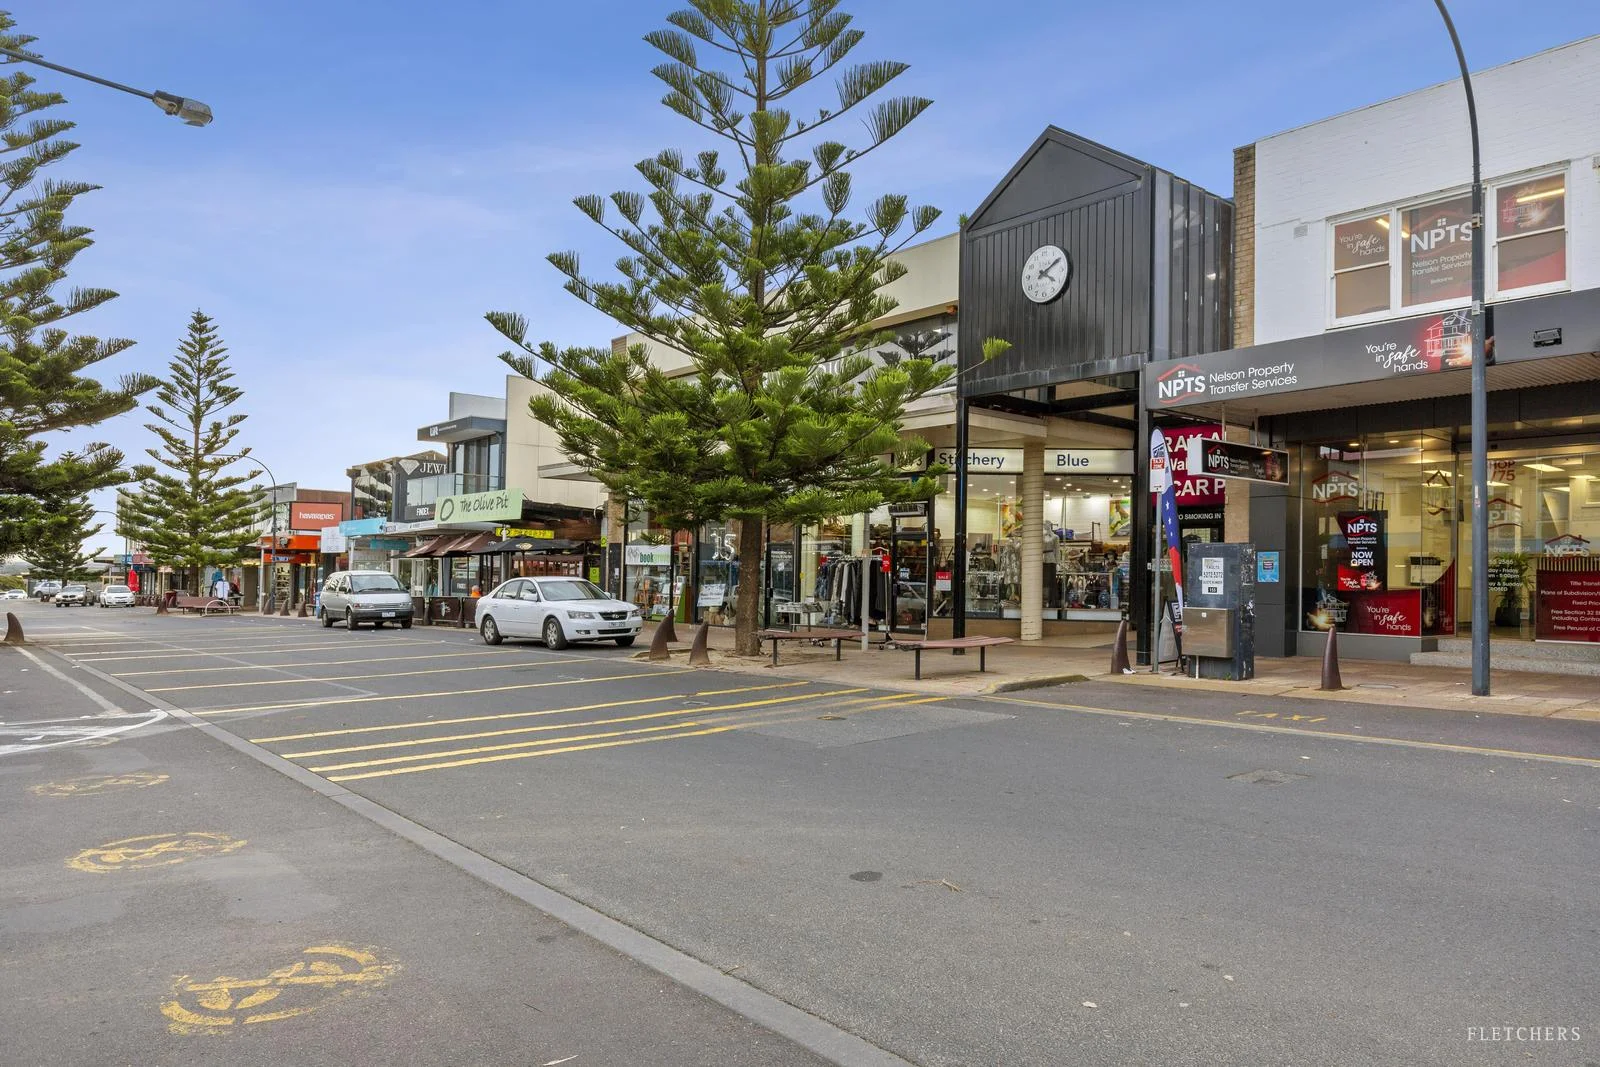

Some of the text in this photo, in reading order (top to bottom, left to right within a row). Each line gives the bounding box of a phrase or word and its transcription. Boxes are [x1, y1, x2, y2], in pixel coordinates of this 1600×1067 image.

[1340, 233, 1362, 244] You're
[1411, 221, 1472, 253] NPTS
[1360, 245, 1385, 256] hands
[1366, 342, 1397, 354] You're
[1376, 344, 1421, 369] in safe
[1209, 362, 1295, 384] Nelson Property
[1394, 360, 1429, 373] hands
[1158, 375, 1206, 399] NPTS
[1209, 374, 1298, 396] Transfer Services
[939, 451, 1090, 469] Stchery Blue
[1208, 454, 1230, 469] NPTS
[1174, 479, 1209, 496] CAR
[1312, 482, 1358, 499] NPTS
[460, 492, 509, 513] The Olive Pit
[1184, 512, 1214, 520] SMOKING
[1347, 523, 1378, 533] NPTS
[1351, 551, 1373, 559] NOW
[1544, 544, 1590, 558] NPTS
[1350, 558, 1374, 567] OPEN
[1366, 605, 1390, 613] You're
[1379, 611, 1407, 625] safe
[1386, 623, 1412, 631] hands
